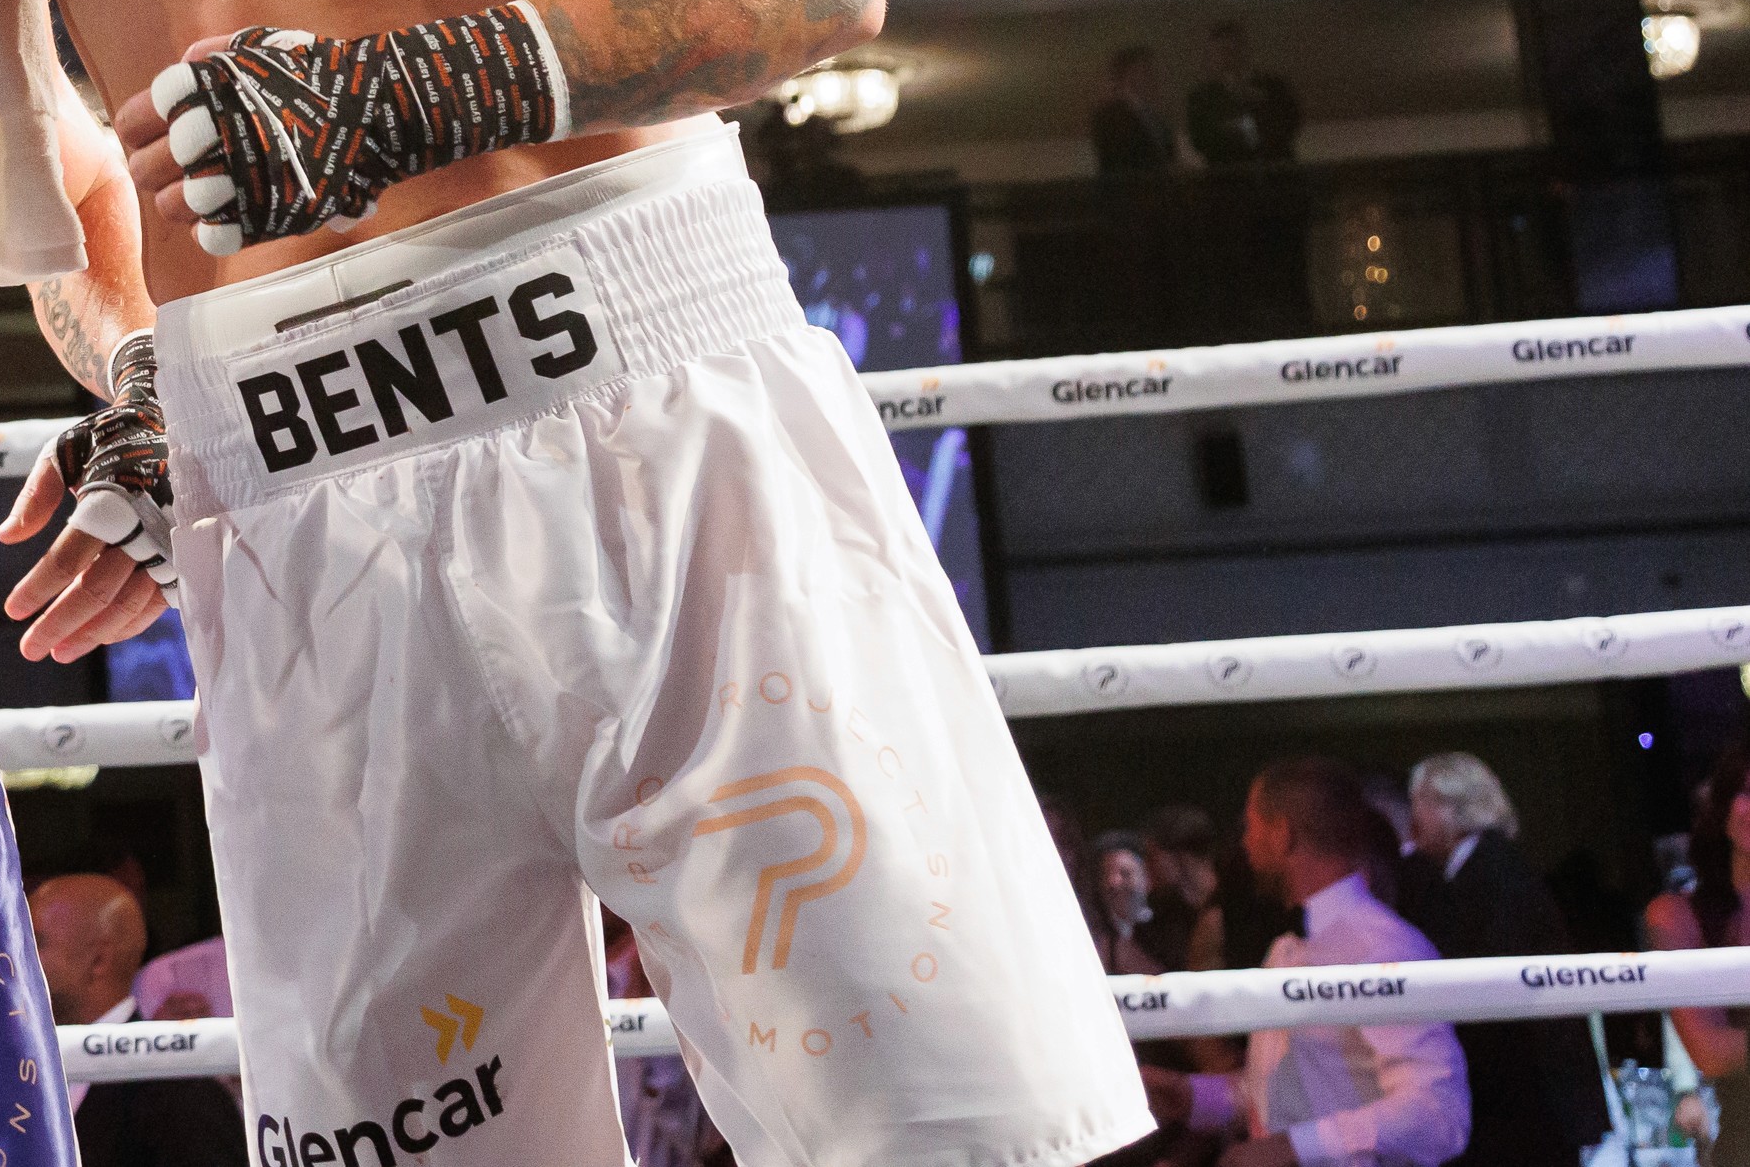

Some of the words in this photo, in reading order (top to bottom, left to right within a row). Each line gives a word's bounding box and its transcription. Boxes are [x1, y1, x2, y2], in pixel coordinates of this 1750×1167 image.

[415, 57, 430, 79] tape
[332, 74, 345, 94] tape
[367, 76, 380, 99] tape
[425, 81, 440, 104] gym
[462, 73, 475, 98] tape
[327, 96, 339, 119] gym
[361, 101, 374, 123] gym
[324, 151, 338, 175] gym
[331, 126, 348, 150] tape
[1513, 334, 1636, 363] Glencar
[237, 272, 599, 473] BENTS
[1281, 354, 1402, 384] Glencar
[1052, 375, 1172, 406] Glencar
[879, 394, 947, 420] ncar
[718, 671, 929, 815] ROJECT
[1521, 962, 1650, 990] Glencar
[1282, 976, 1407, 1004] Glencar
[83, 1030, 199, 1056] Glencar
[257, 1054, 504, 1167] Glencar
